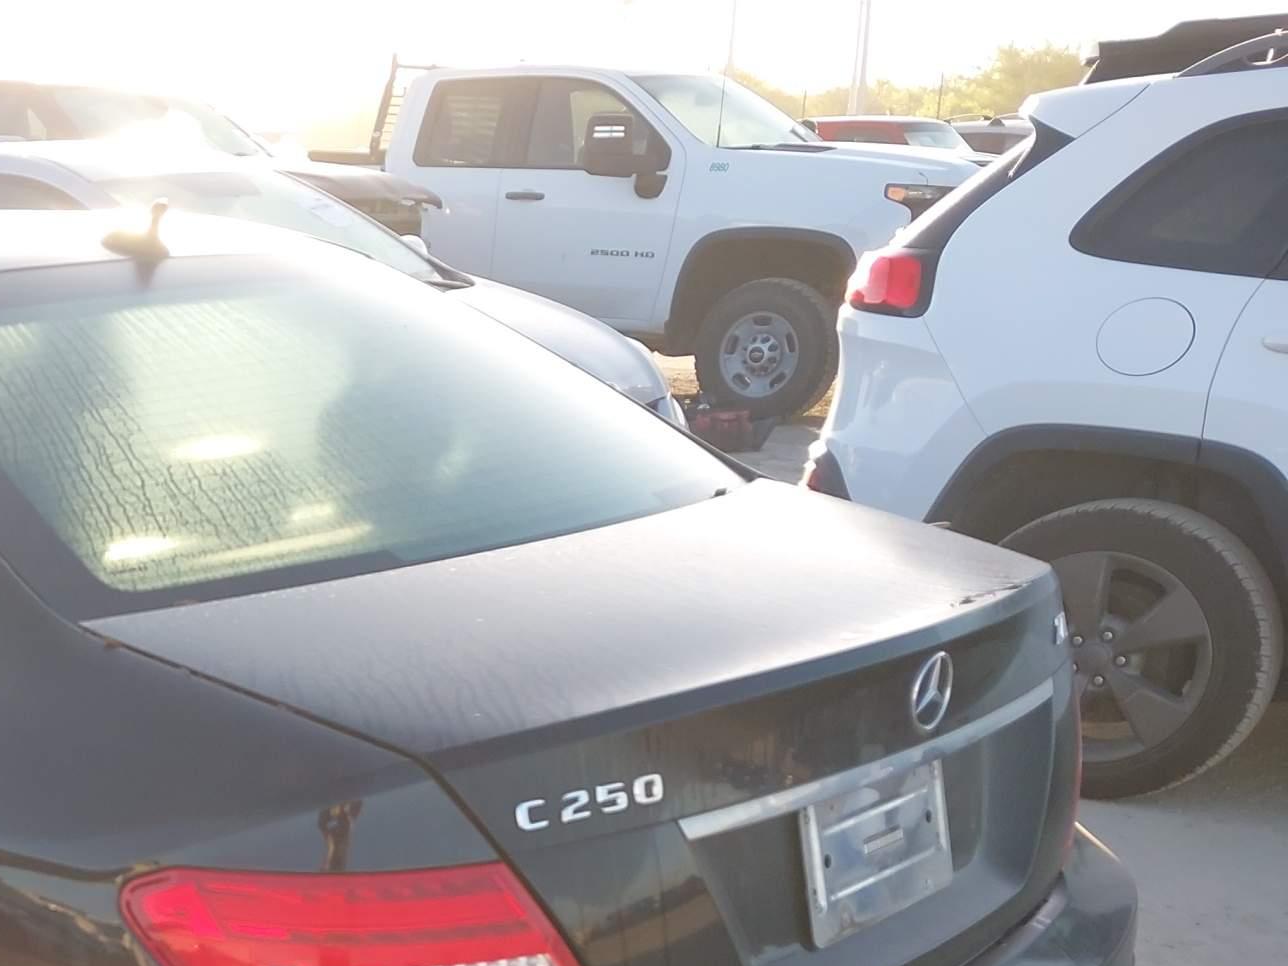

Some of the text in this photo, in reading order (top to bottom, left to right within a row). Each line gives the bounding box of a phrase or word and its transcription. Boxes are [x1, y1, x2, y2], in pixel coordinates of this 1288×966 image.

[590, 249, 630, 257] 2500
[515, 773, 664, 831] C 250
